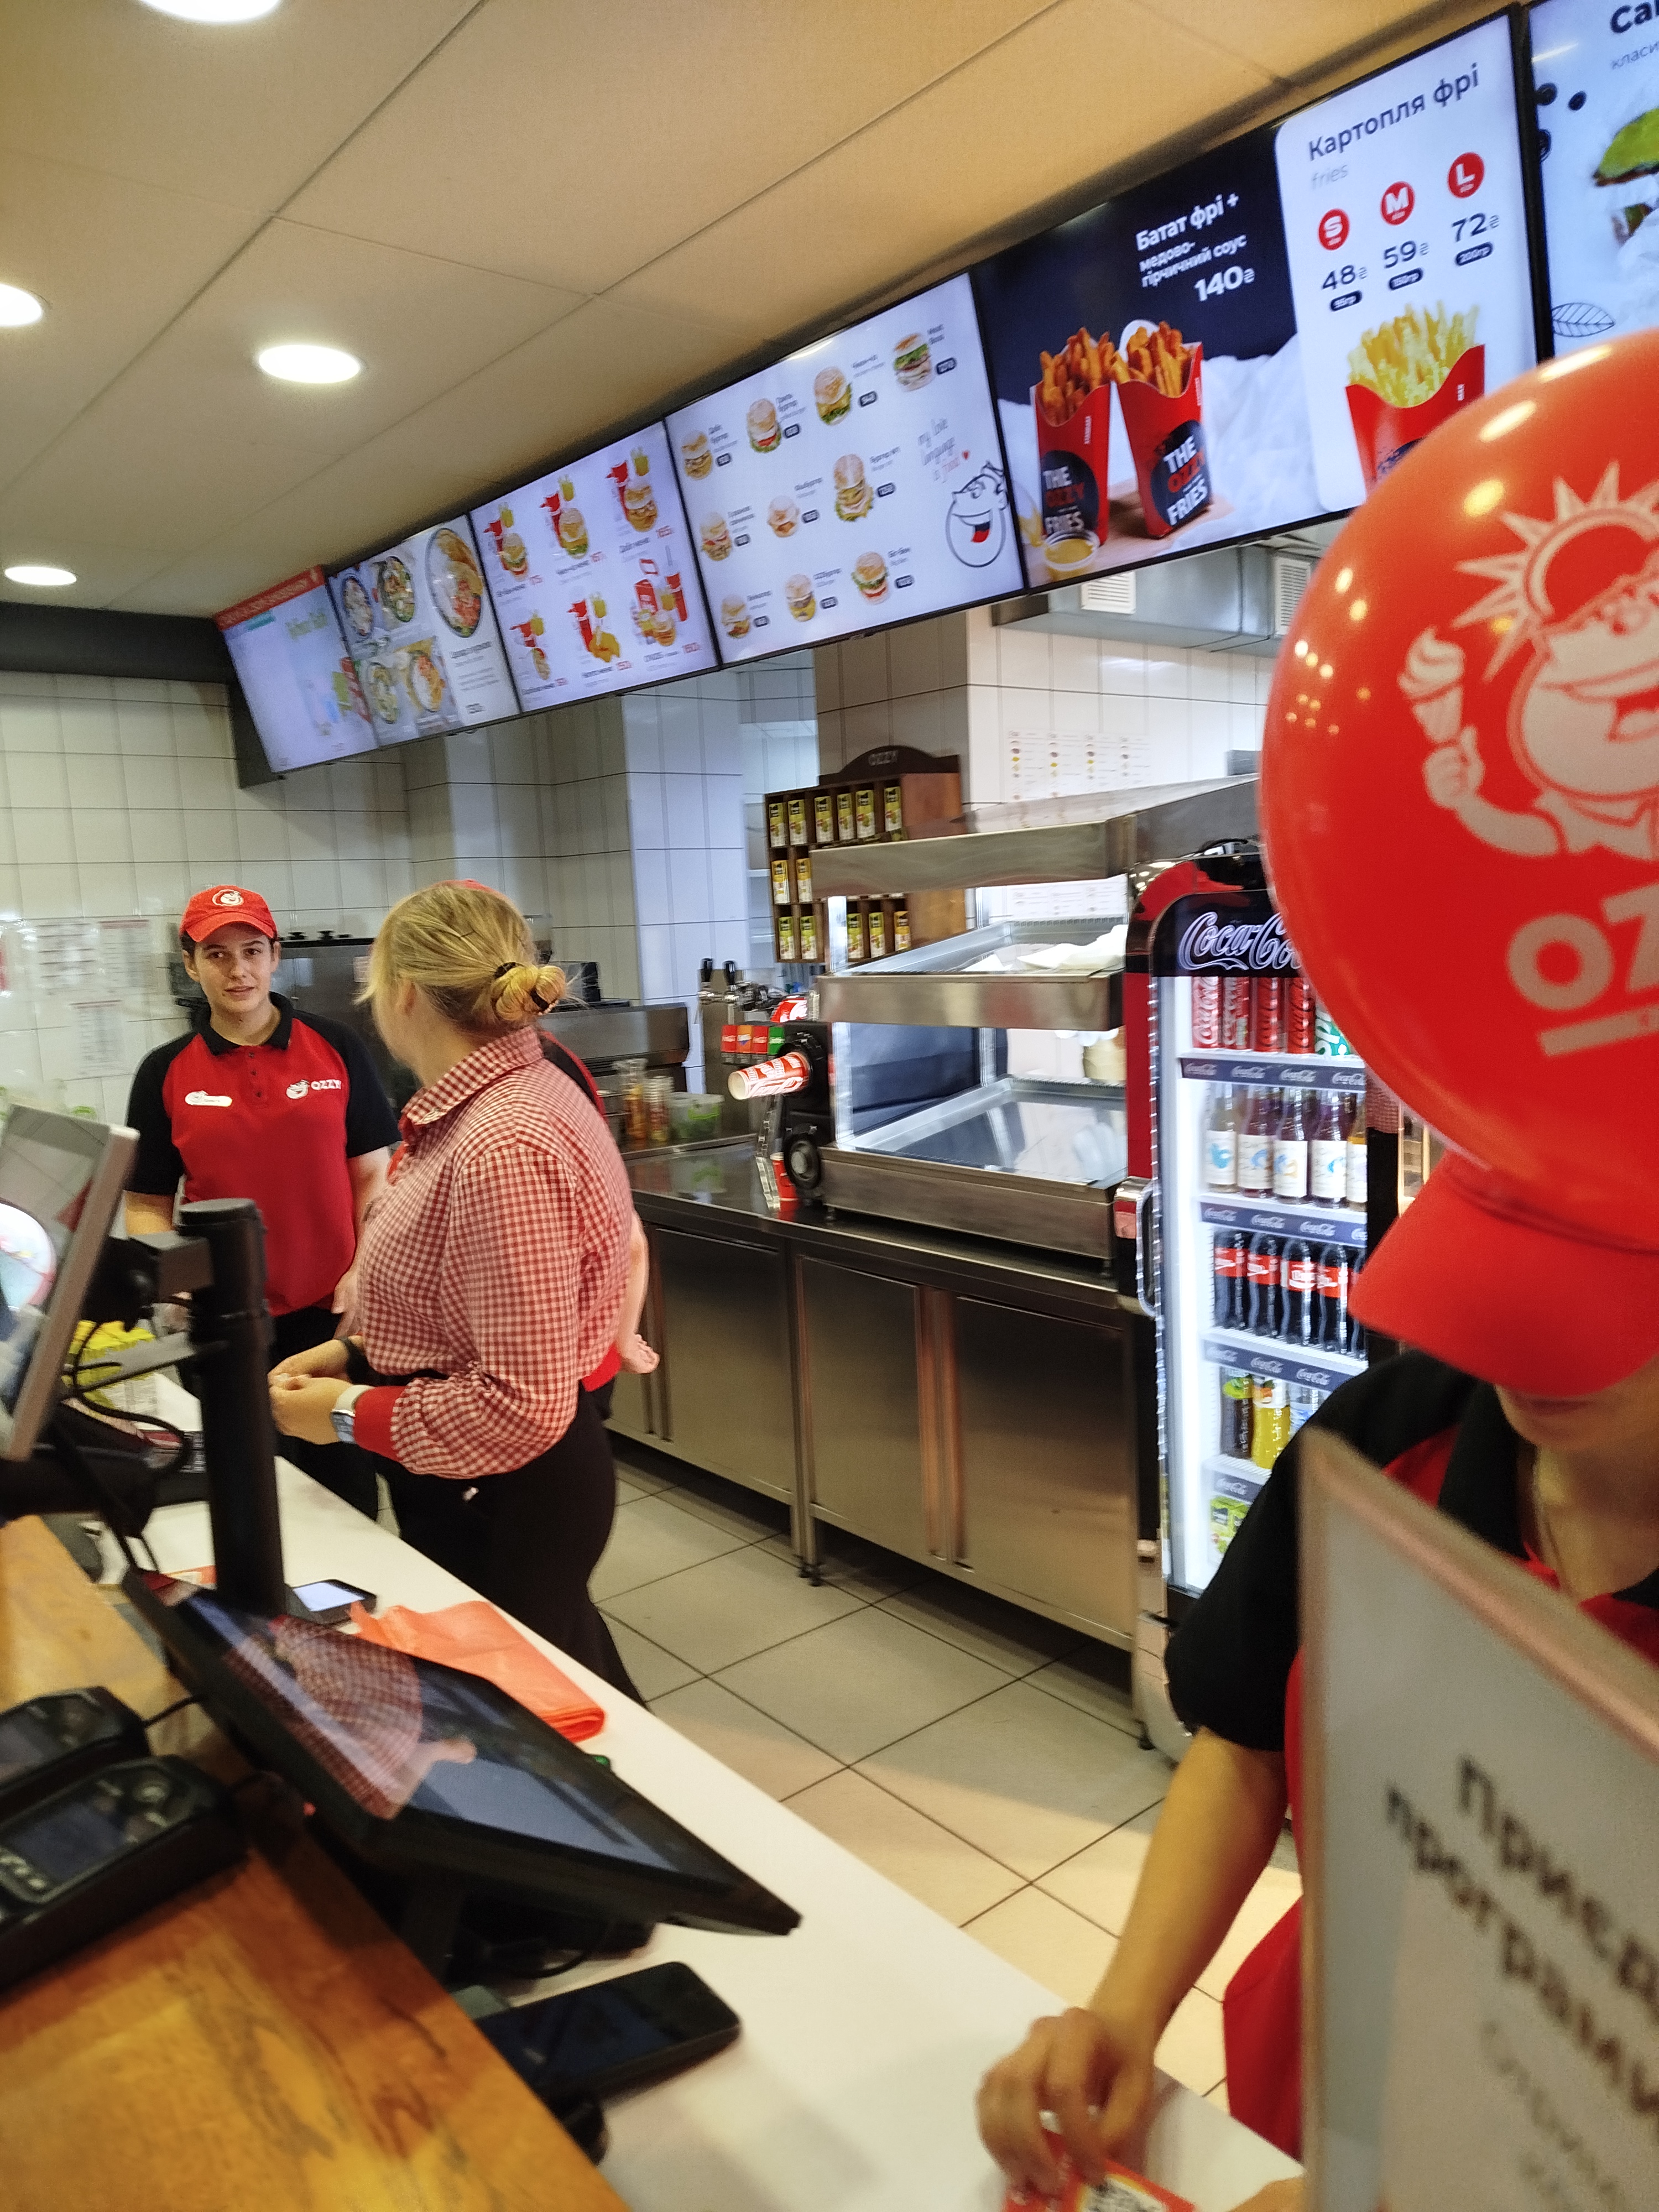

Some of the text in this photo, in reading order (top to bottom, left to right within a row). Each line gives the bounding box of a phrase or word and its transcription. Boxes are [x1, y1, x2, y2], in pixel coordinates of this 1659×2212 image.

[1308, 61, 1479, 161] Картопля фрі
[1311, 164, 1349, 190] fries
[1455, 163, 1476, 186] L
[1385, 186, 1410, 216] M
[1135, 216, 1188, 251] Батат
[1190, 194, 1224, 229] фрі
[1323, 215, 1344, 239] S
[1213, 234, 1248, 258] соус
[1163, 435, 1198, 474] THE
[1043, 465, 1072, 490] THE
[1166, 478, 1208, 526] FRIES
[1178, 911, 1303, 971] Coca-Co
[310, 1079, 342, 1091] OZZY
